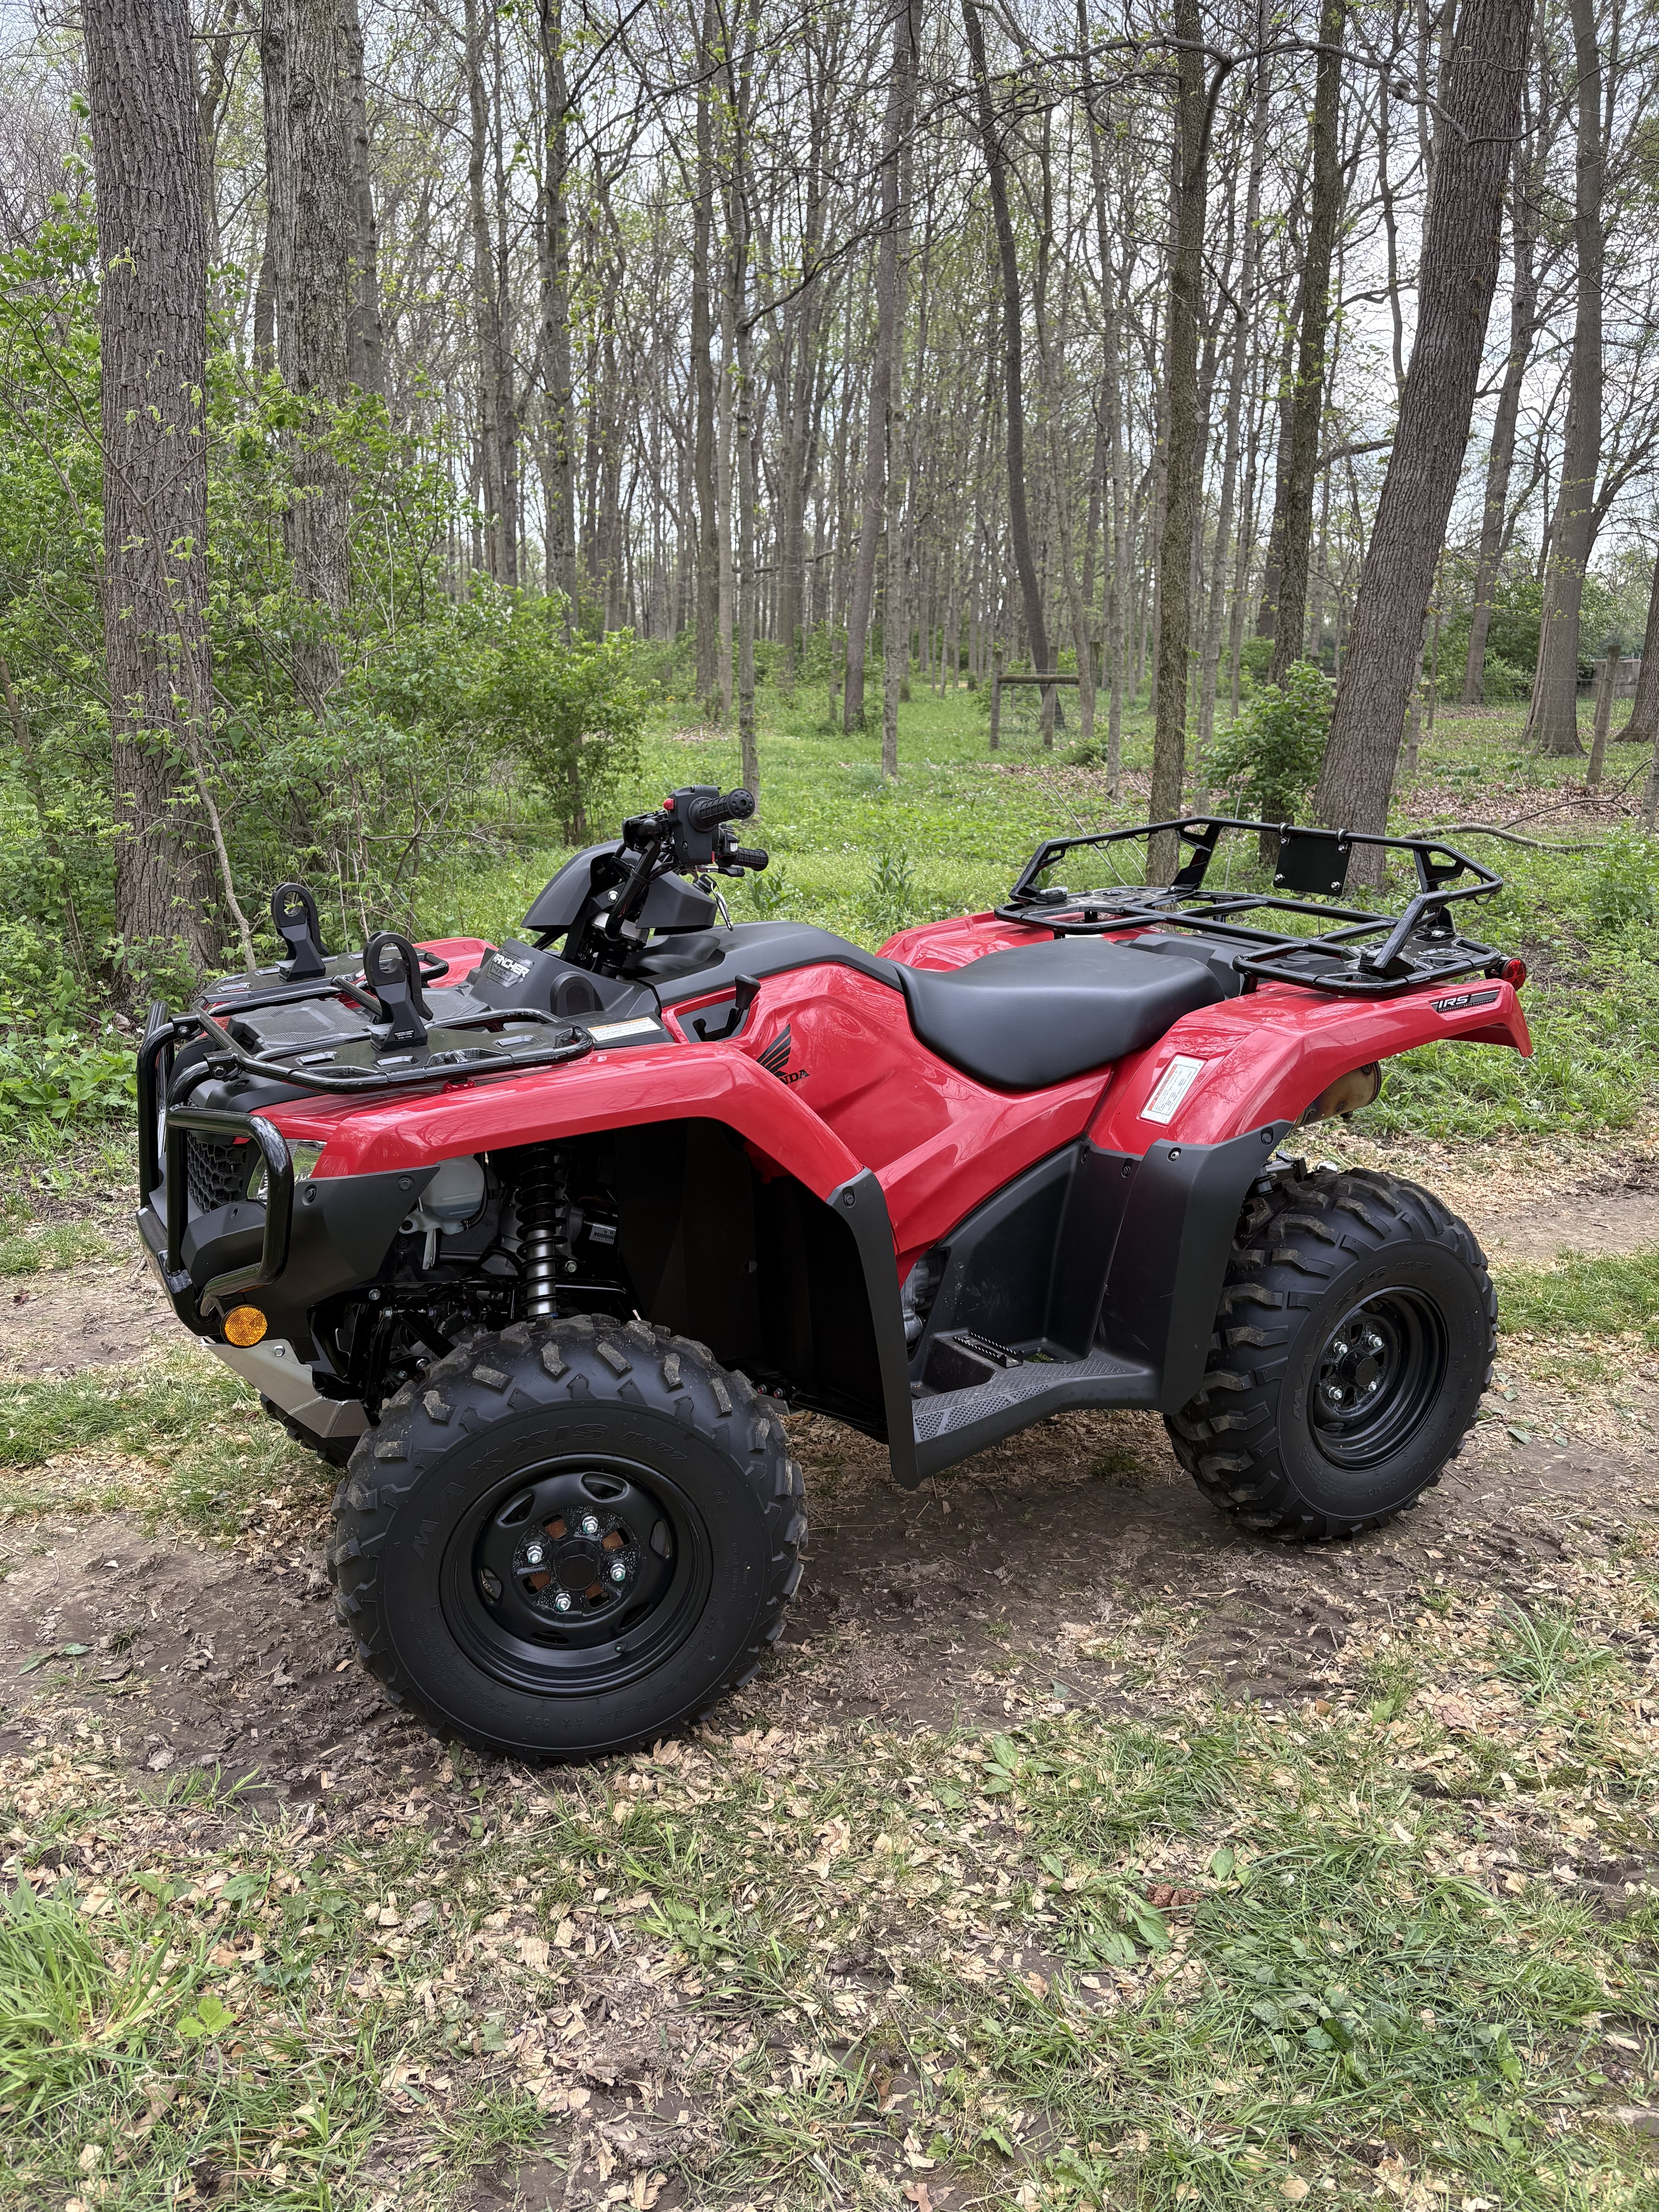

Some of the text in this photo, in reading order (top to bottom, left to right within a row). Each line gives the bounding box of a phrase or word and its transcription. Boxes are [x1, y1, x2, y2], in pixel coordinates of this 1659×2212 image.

[492, 953, 530, 978] RANCHER
[1438, 995, 1469, 1008] IRS
[779, 1069, 810, 1085] NDA
[412, 1424, 688, 1562] MAXXIS M977
